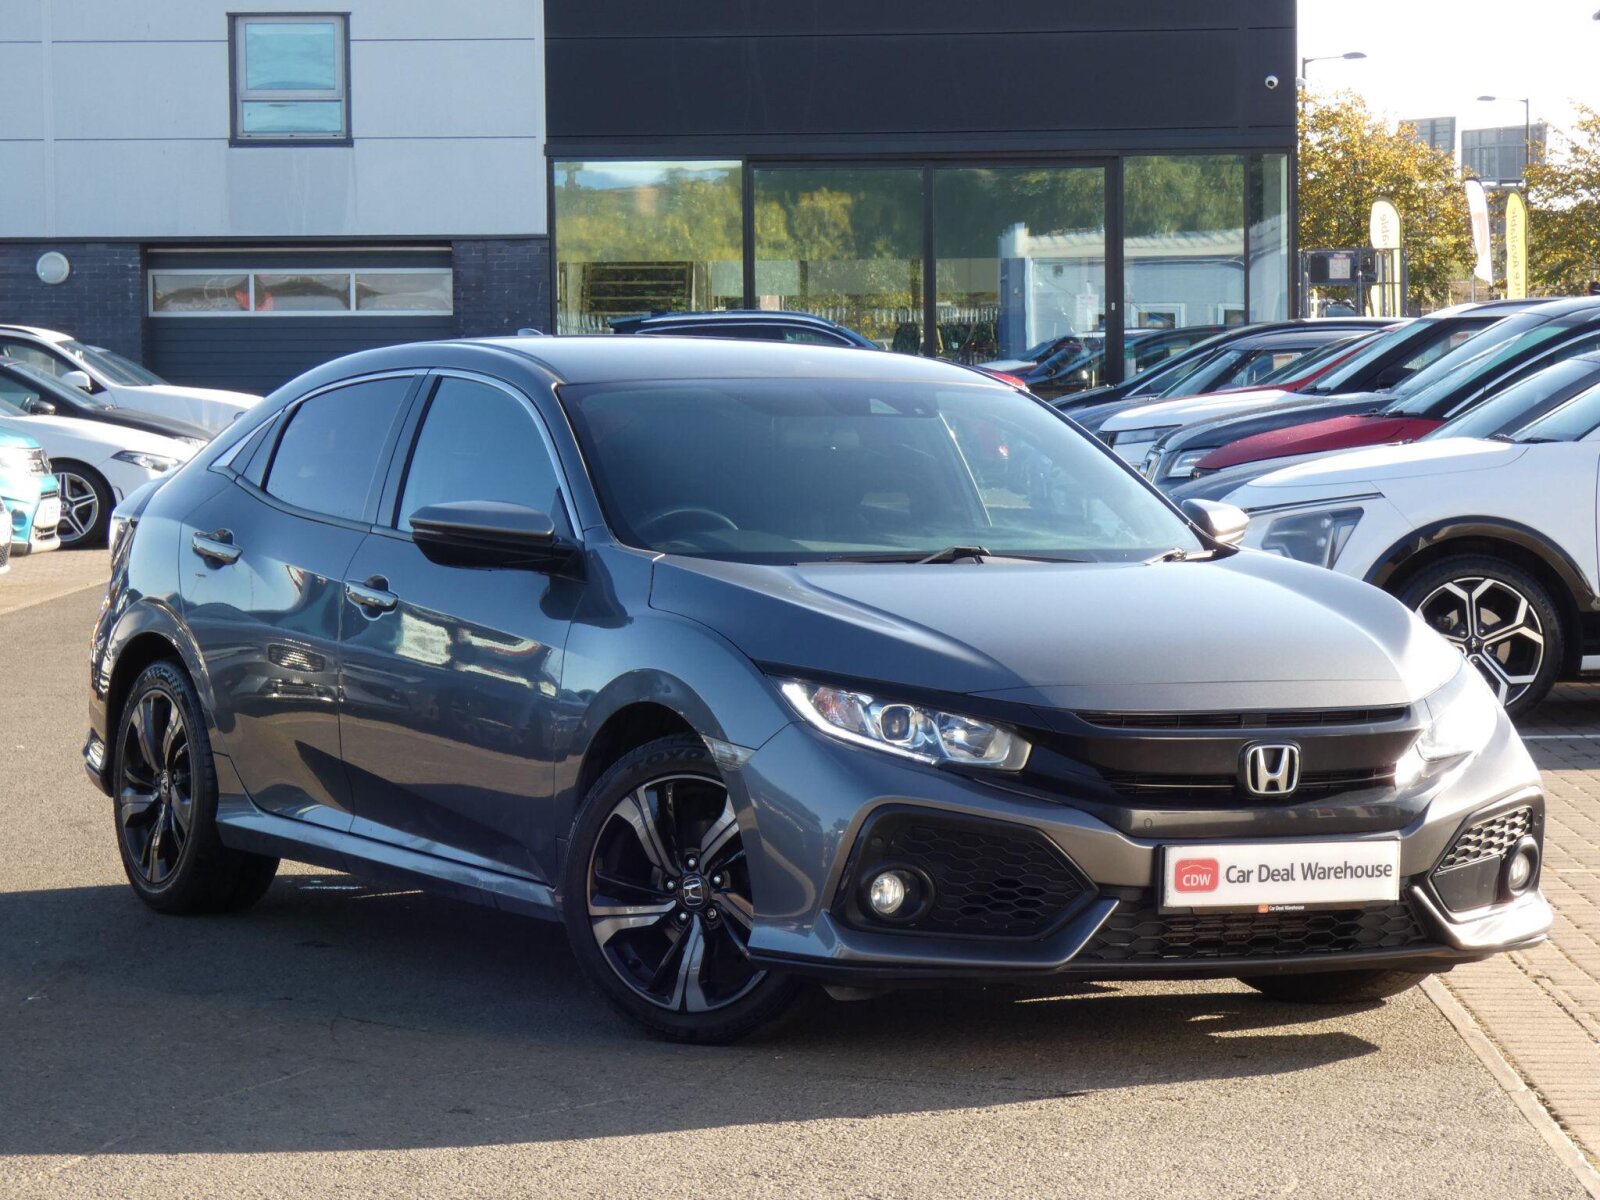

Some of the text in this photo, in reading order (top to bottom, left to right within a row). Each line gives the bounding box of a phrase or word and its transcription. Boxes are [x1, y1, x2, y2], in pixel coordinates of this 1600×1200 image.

[1182, 873, 1211, 887] CDW
[1225, 860, 1393, 884] Car Deal Warehouse
